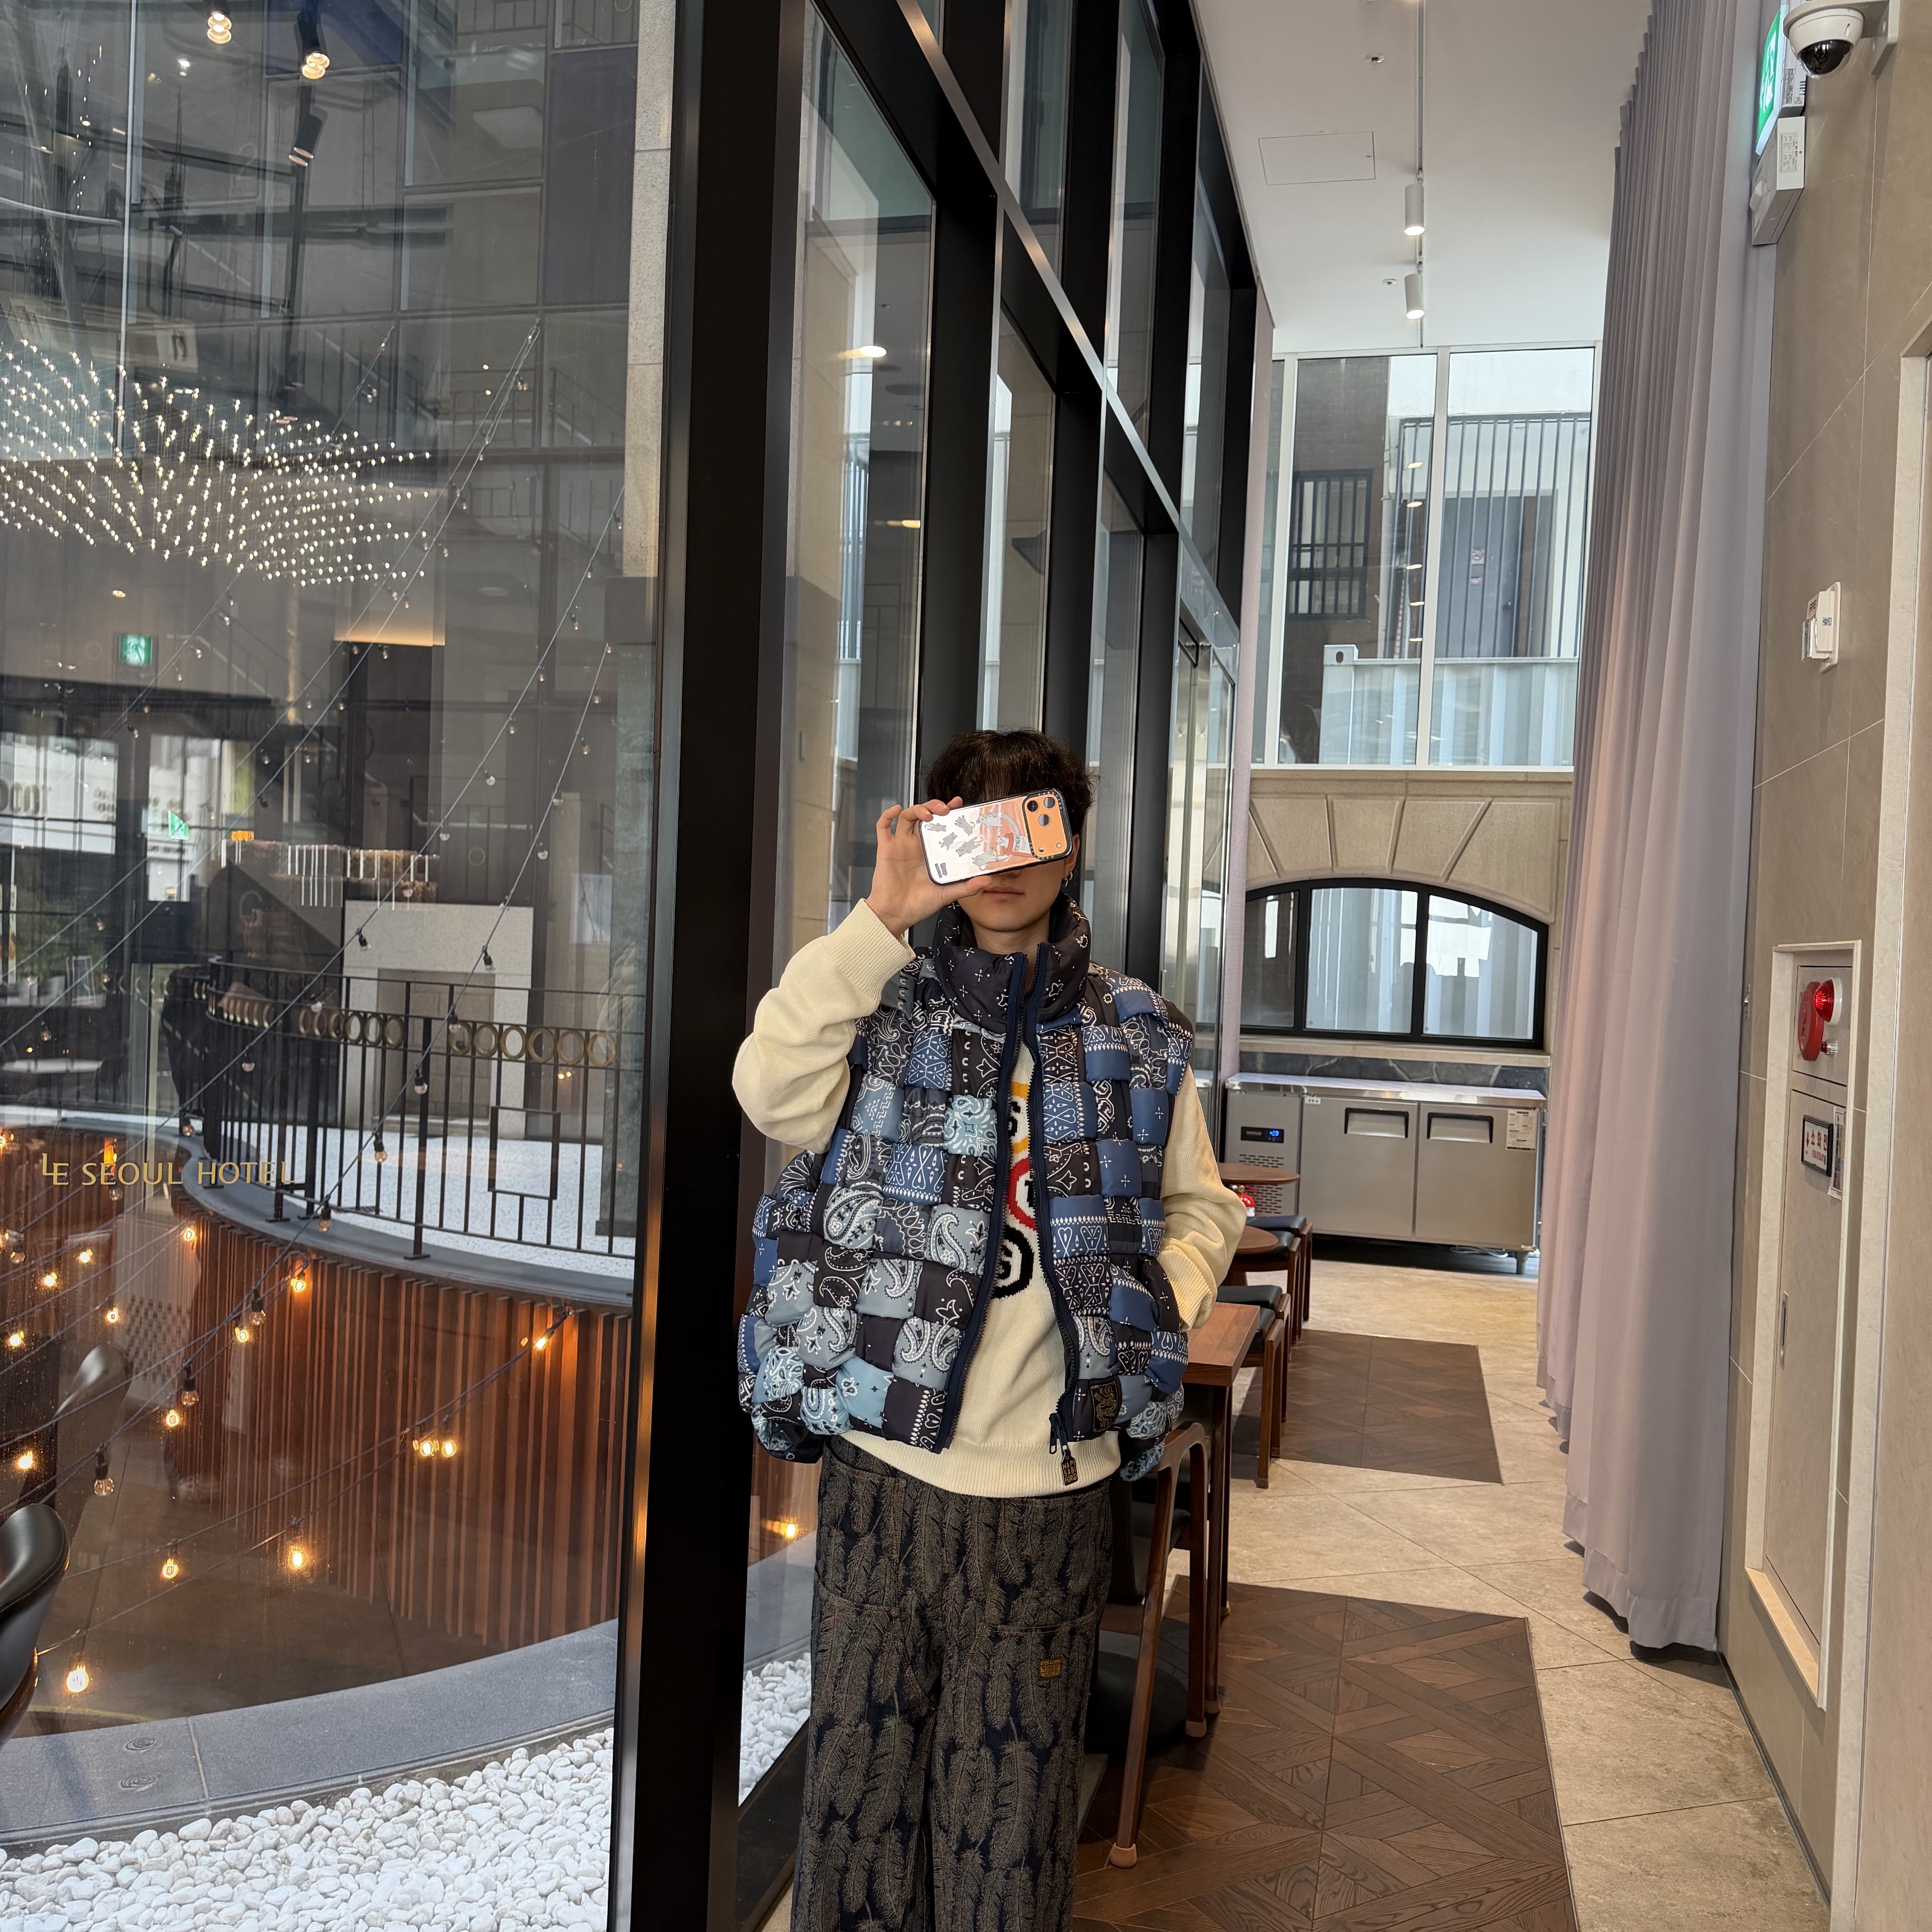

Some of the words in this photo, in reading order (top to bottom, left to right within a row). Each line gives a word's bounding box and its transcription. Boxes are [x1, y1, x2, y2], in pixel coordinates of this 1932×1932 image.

[41, 1153, 69, 1185] LE
[82, 1162, 183, 1185] SEOUL
[198, 1161, 295, 1184] HOTEL
